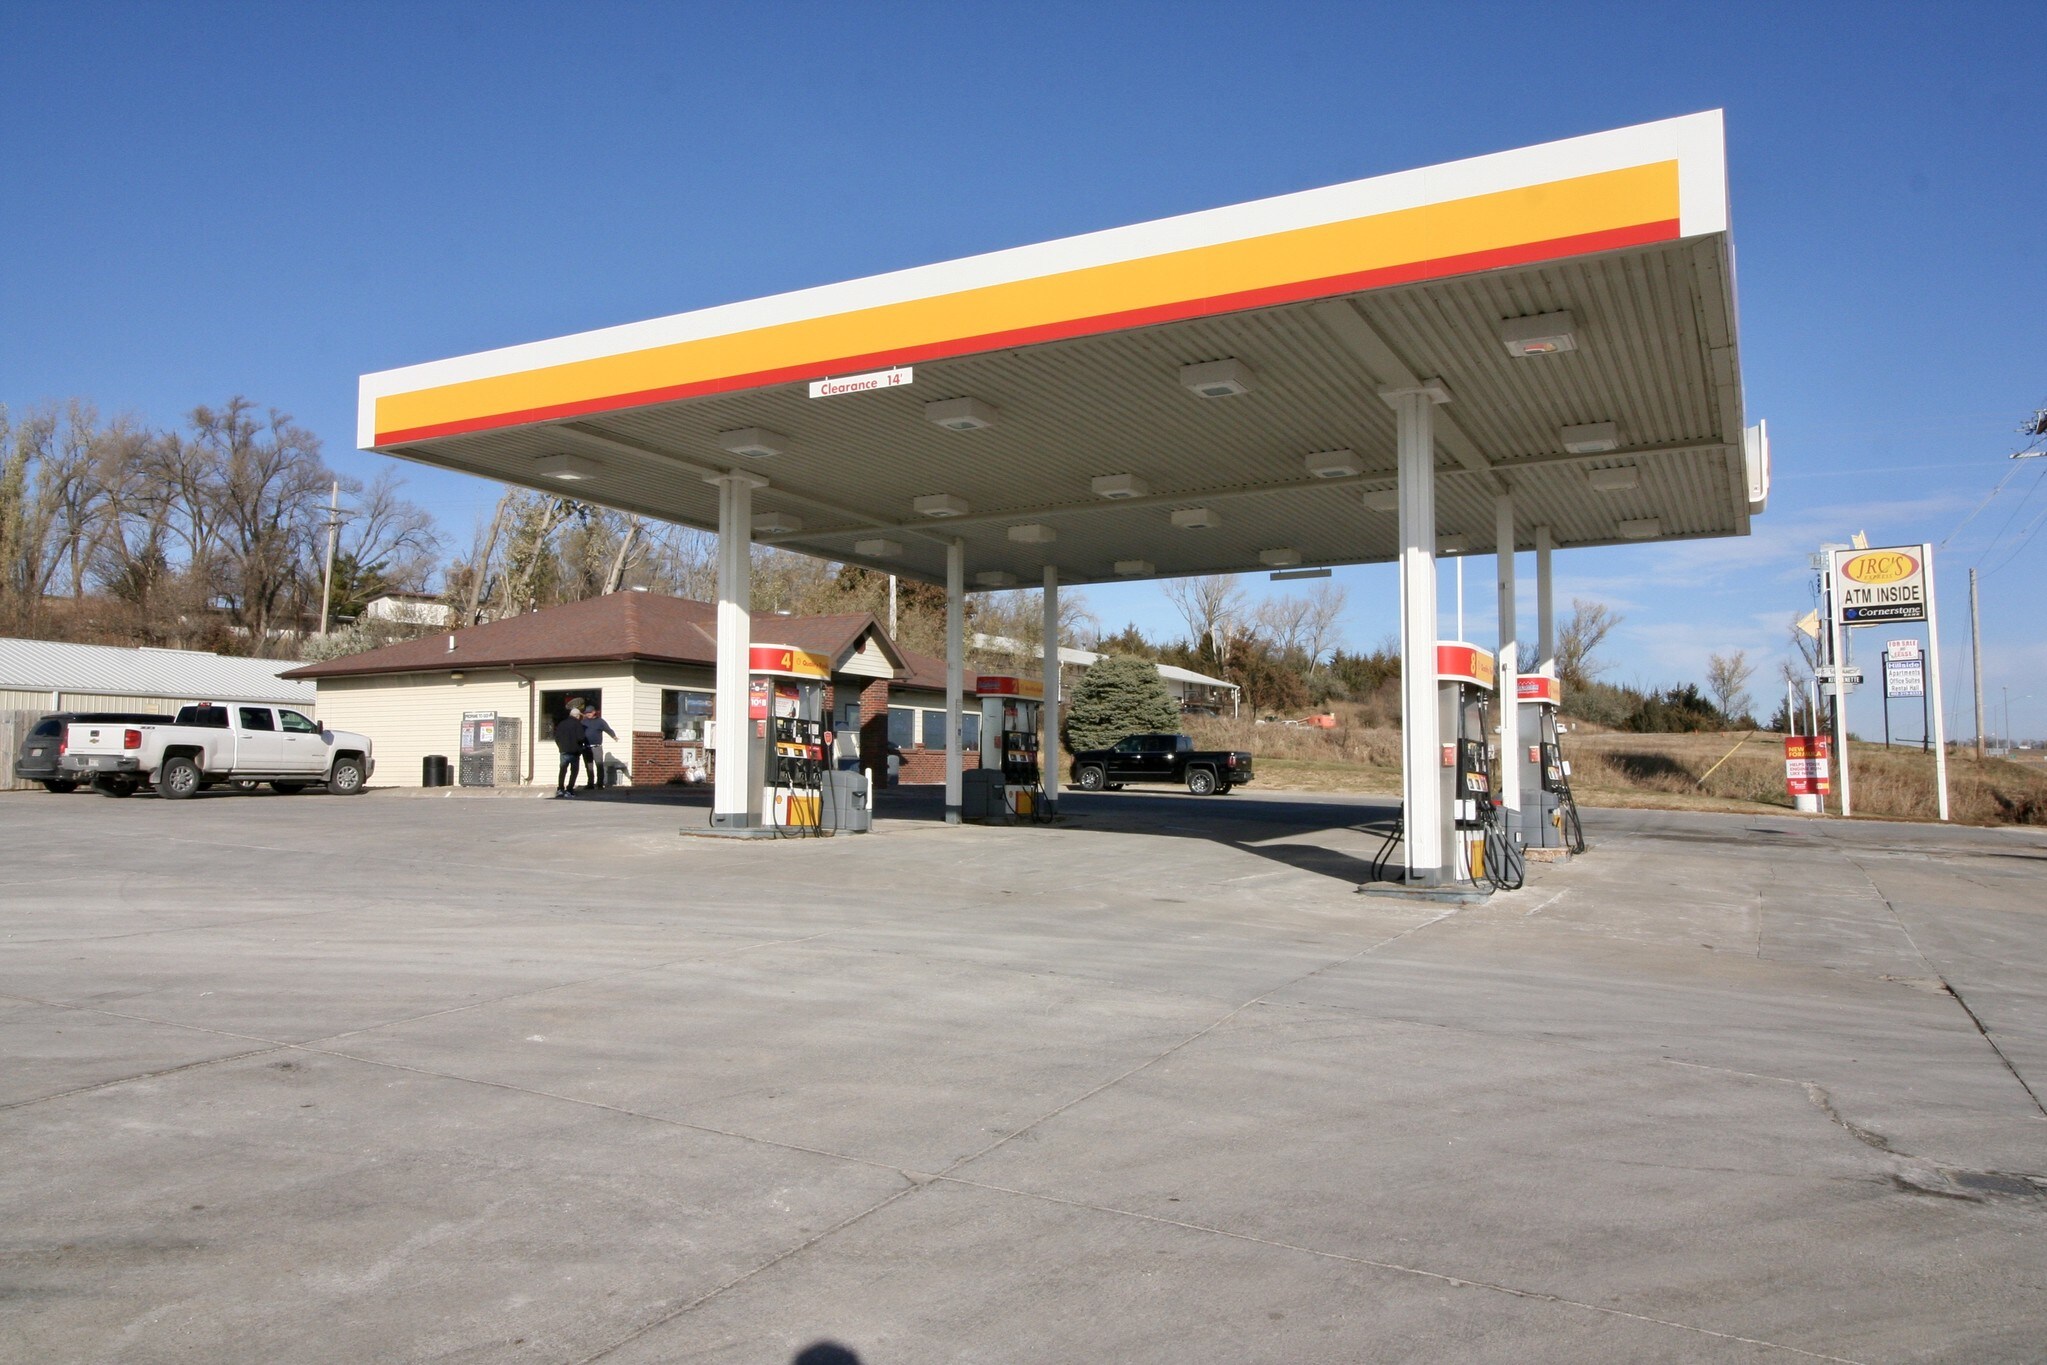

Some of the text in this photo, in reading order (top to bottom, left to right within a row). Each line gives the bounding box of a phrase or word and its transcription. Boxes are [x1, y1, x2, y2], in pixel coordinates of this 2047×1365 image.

[821, 373, 903, 395] Clearance 14'
[1857, 556, 1904, 579] JRC'S
[1845, 585, 1920, 605] ATM INSIDE
[1858, 606, 1922, 617] Cornerstone
[780, 652, 792, 669] 4
[1470, 653, 1476, 675] 8
[1888, 661, 1920, 669] Hillside
[1888, 670, 1921, 678] Apartments
[1905, 676, 1921, 685] Suites
